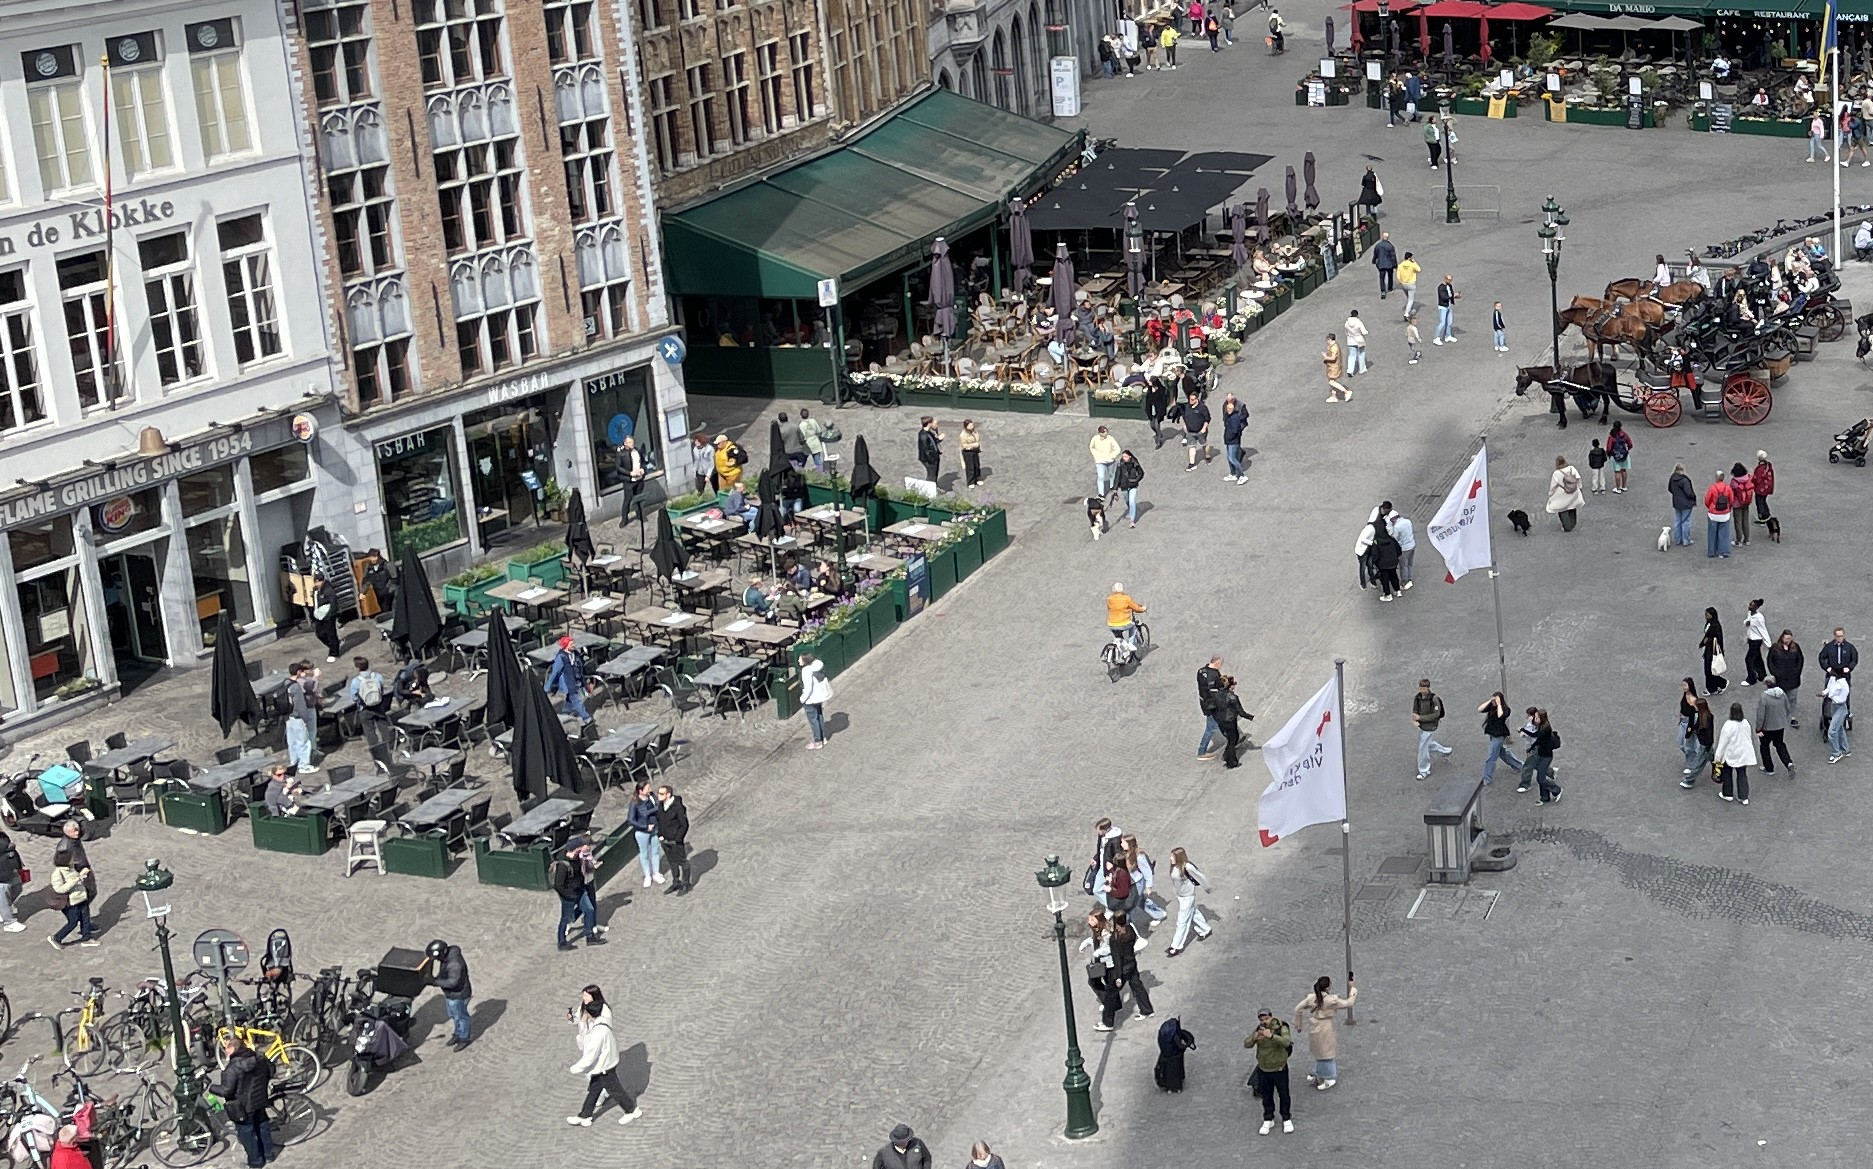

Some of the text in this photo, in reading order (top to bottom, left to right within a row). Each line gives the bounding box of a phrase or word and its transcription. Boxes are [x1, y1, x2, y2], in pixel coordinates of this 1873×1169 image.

[1754, 10, 1811, 20] RESTAURANT
[27, 221, 60, 248] de
[69, 199, 175, 240] Klokke
[488, 372, 550, 403] WASBAR
[61, 460, 148, 506] GRILLING
[152, 446, 202, 478] SINCE
[208, 431, 253, 461] 1954
